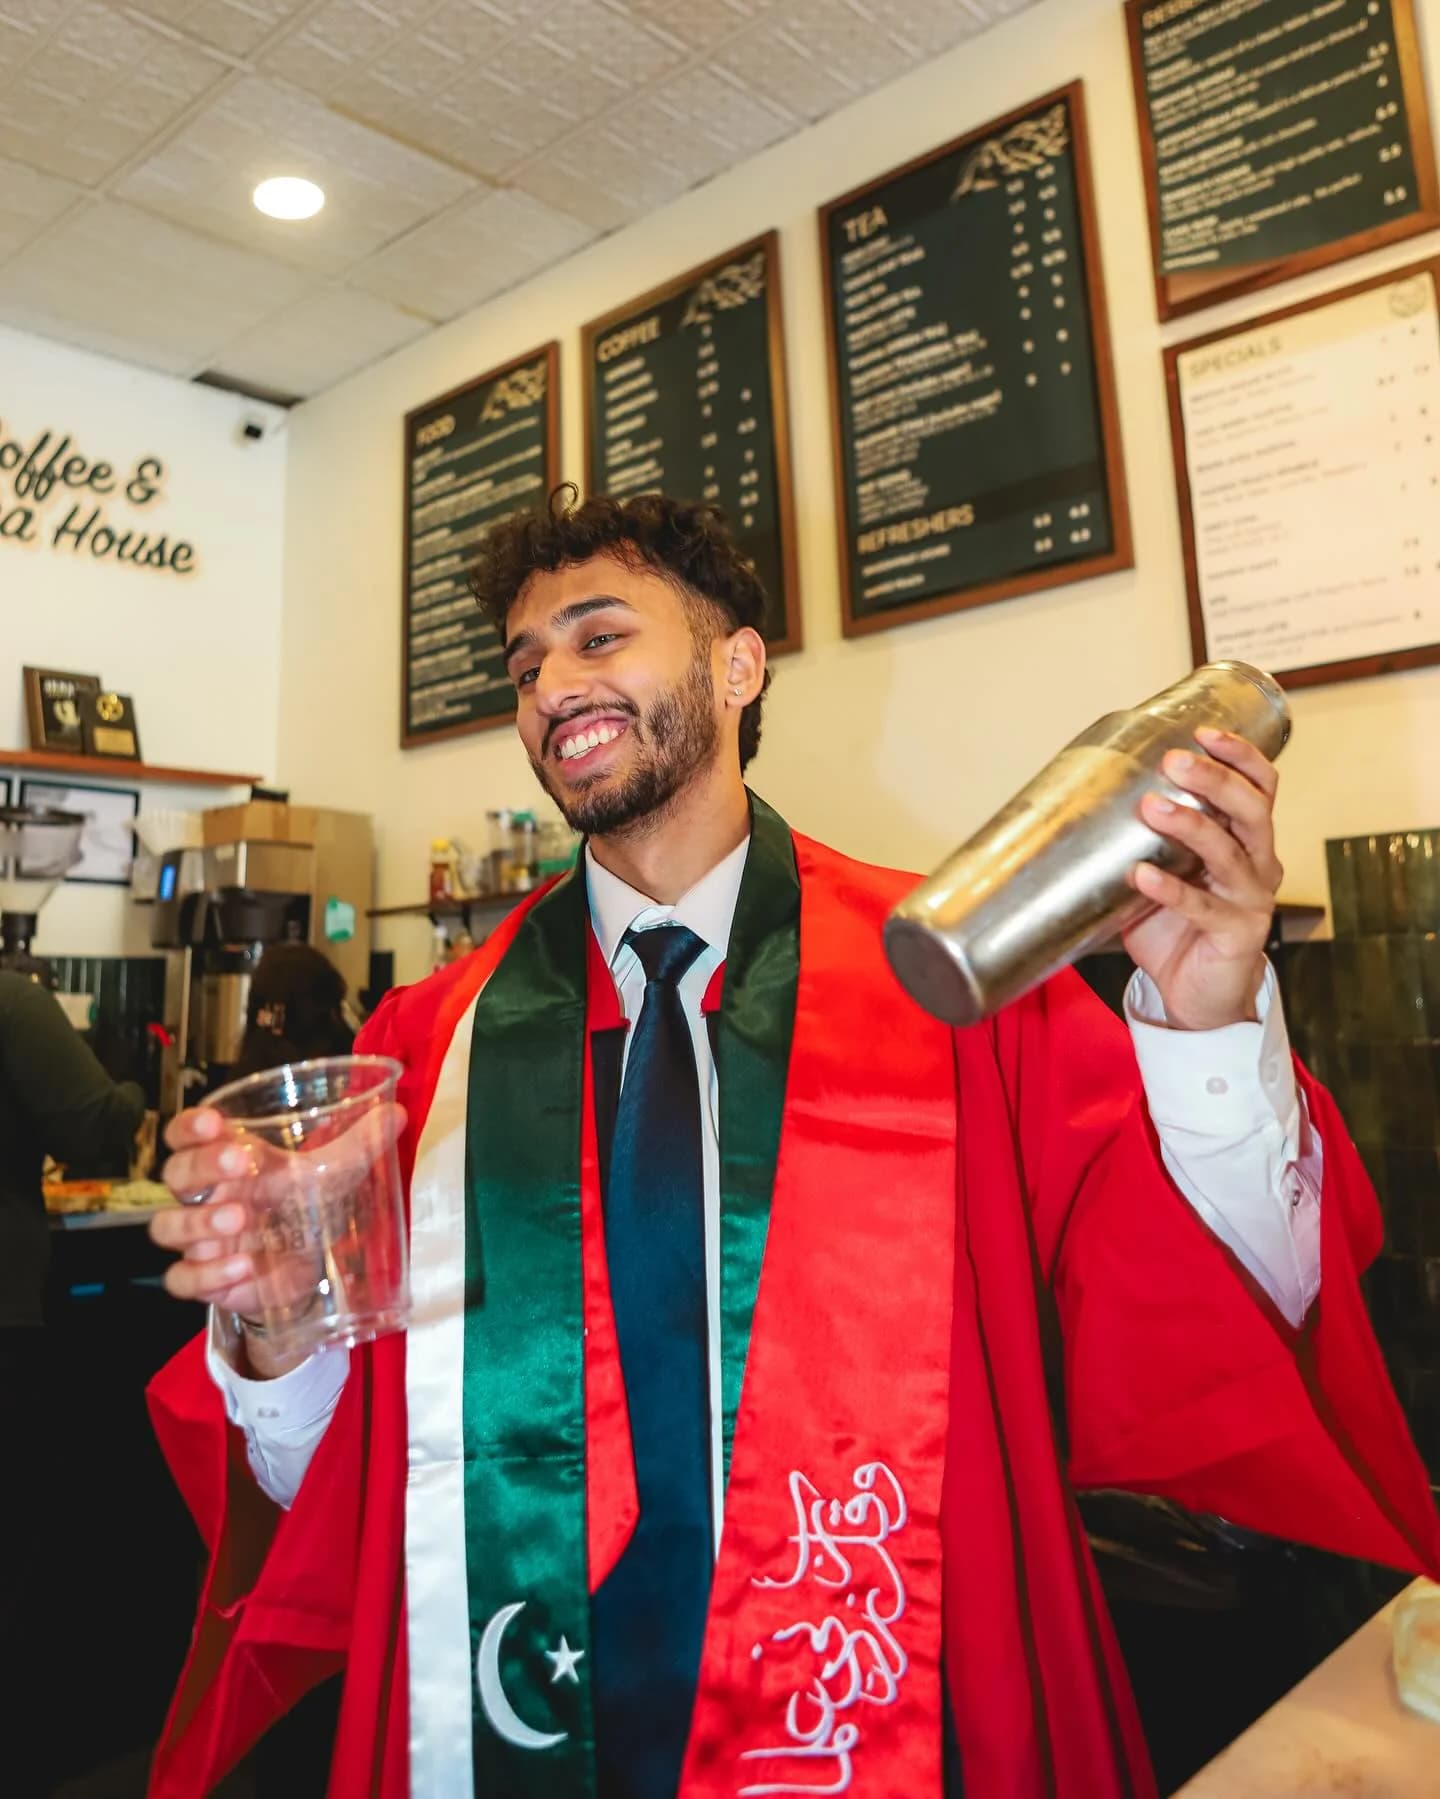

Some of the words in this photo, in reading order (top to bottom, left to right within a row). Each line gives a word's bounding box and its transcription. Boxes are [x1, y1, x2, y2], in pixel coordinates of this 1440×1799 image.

[842, 206, 888, 243] TEA
[598, 316, 661, 362] COFFEE
[1189, 335, 1283, 378] SPECIALS
[0, 431, 117, 502] offee
[126, 457, 163, 505] &
[53, 504, 196, 574] House
[857, 504, 975, 555] REFRESHERS
